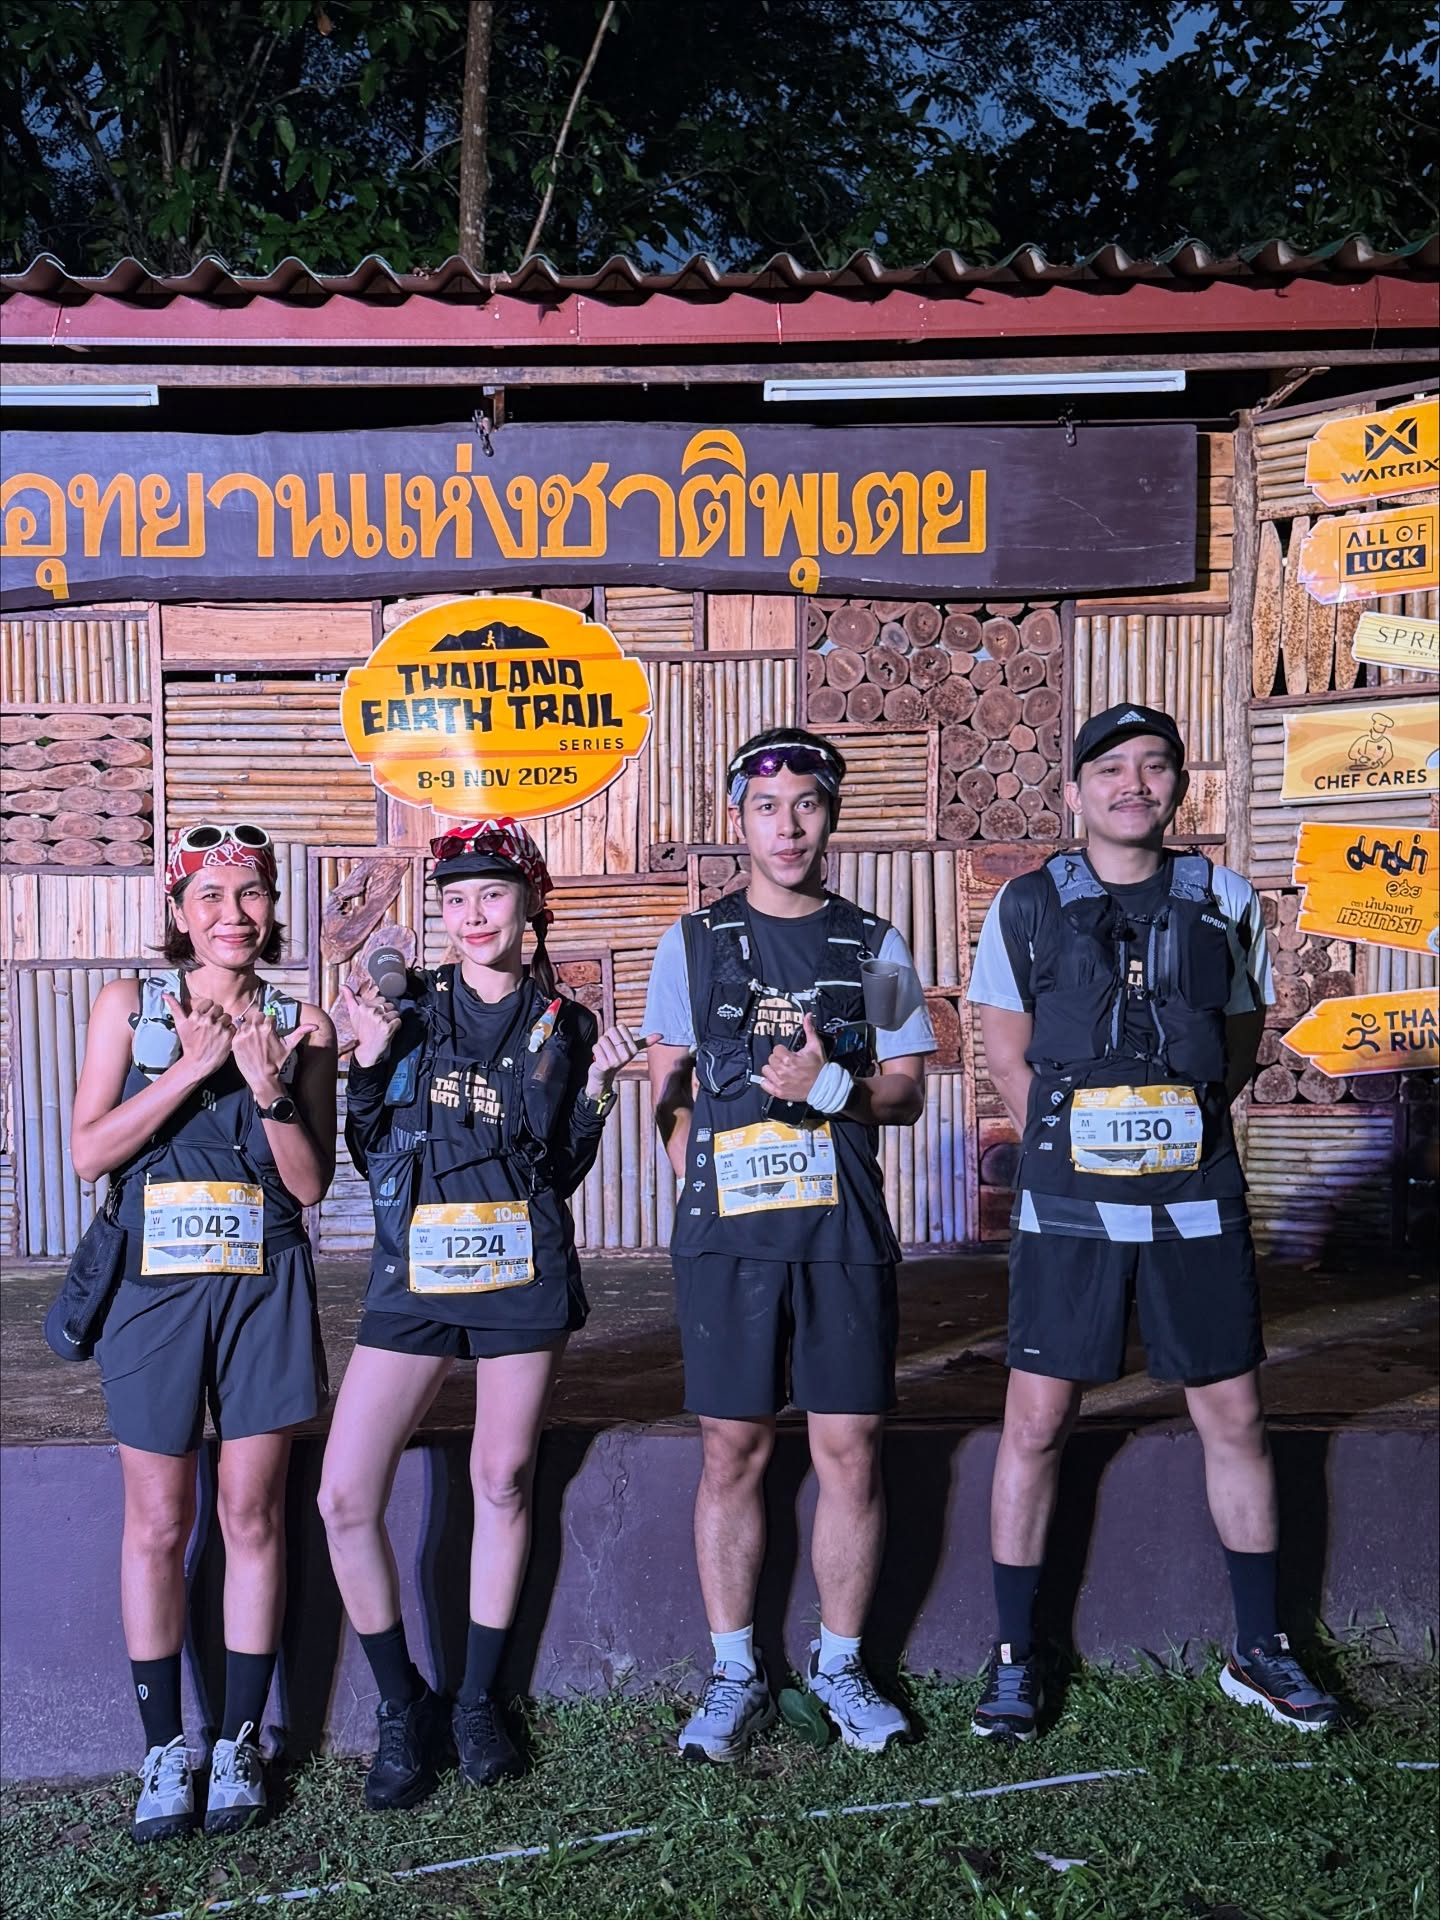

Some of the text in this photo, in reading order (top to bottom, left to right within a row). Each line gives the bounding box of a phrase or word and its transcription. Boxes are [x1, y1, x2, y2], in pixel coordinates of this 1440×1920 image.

[1341, 457, 1439, 485] WARRIX
[1346, 523, 1427, 549] ALL OF
[1352, 546, 1420, 573] LUCK
[397, 658, 585, 696] THAILAND
[360, 693, 623, 737] EARTH TRAIL
[559, 738, 625, 751] SERIES
[417, 766, 578, 789] 8-9 NOV 2025
[1314, 769, 1428, 790] CHEF CARES
[1337, 907, 1423, 936] หอยนางรม
[1106, 1118, 1173, 1143] 1130
[746, 1151, 808, 1178] 1150
[171, 1215, 241, 1239] 1042
[441, 1234, 506, 1259] 1224
